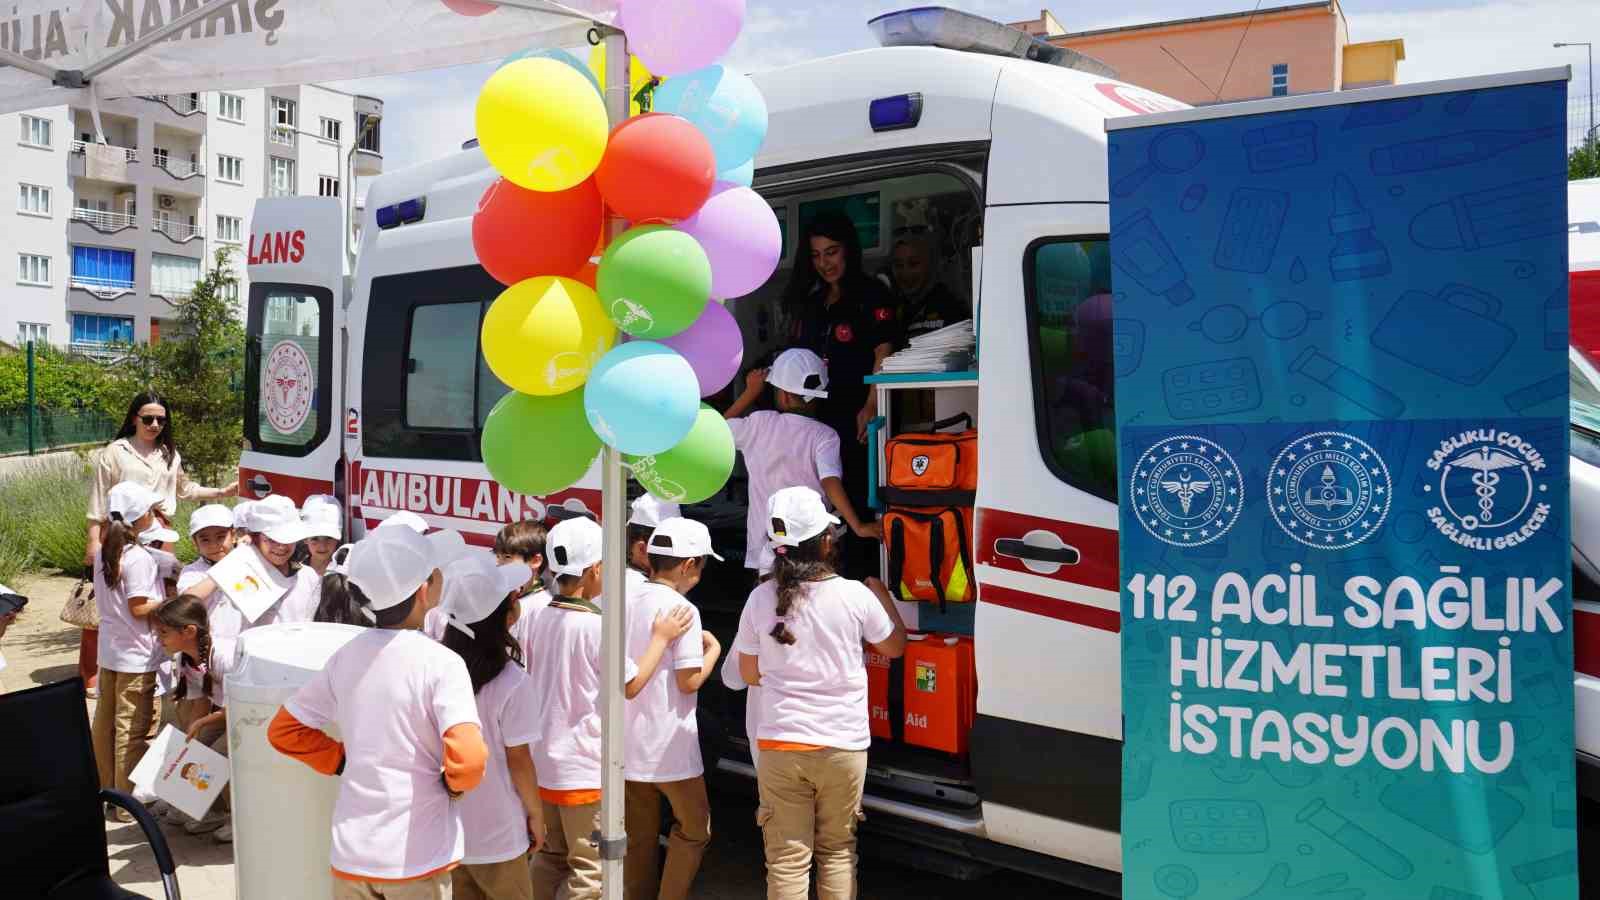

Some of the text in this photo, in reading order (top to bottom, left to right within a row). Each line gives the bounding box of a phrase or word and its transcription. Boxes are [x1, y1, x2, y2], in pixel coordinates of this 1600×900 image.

[1426, 428, 1546, 472] SAĞLIKLI ÇOCUK
[362, 469, 547, 524] AMBULANS
[1426, 502, 1551, 550] SAĞLIKLI GELECEK
[1126, 562, 1564, 634] 112 ACİL SAĞLIK
[1169, 626, 1513, 704] HİZMETLERİ
[904, 712, 929, 729] Aid
[1168, 690, 1515, 775] İSTASYONU
